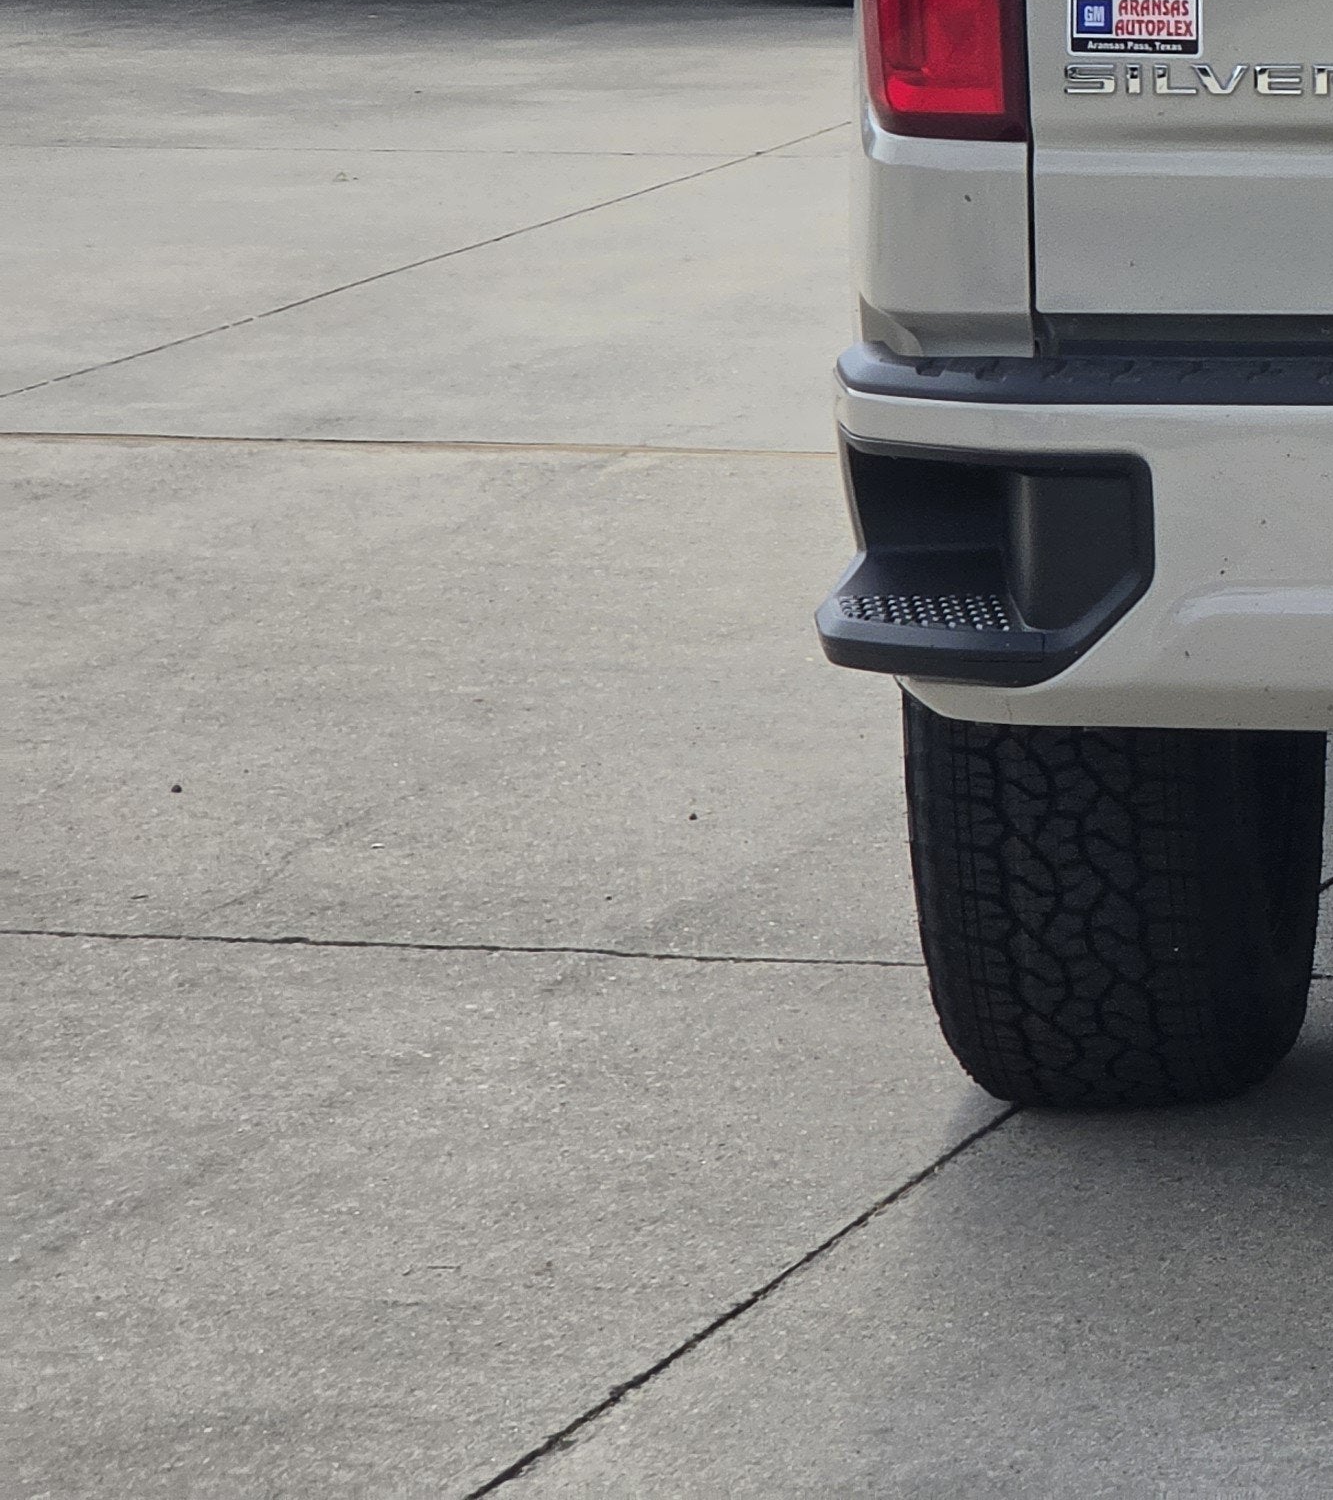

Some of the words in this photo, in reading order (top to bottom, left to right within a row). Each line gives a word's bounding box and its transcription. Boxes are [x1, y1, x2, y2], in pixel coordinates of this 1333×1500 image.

[1084, 6, 1104, 22] GM
[1118, 0, 1189, 17] ARANSAS
[1115, 19, 1193, 37] AUTOPLEX
[1087, 41, 1125, 50] Aransas
[1127, 41, 1152, 51] Pass,
[1155, 42, 1182, 51] Texas
